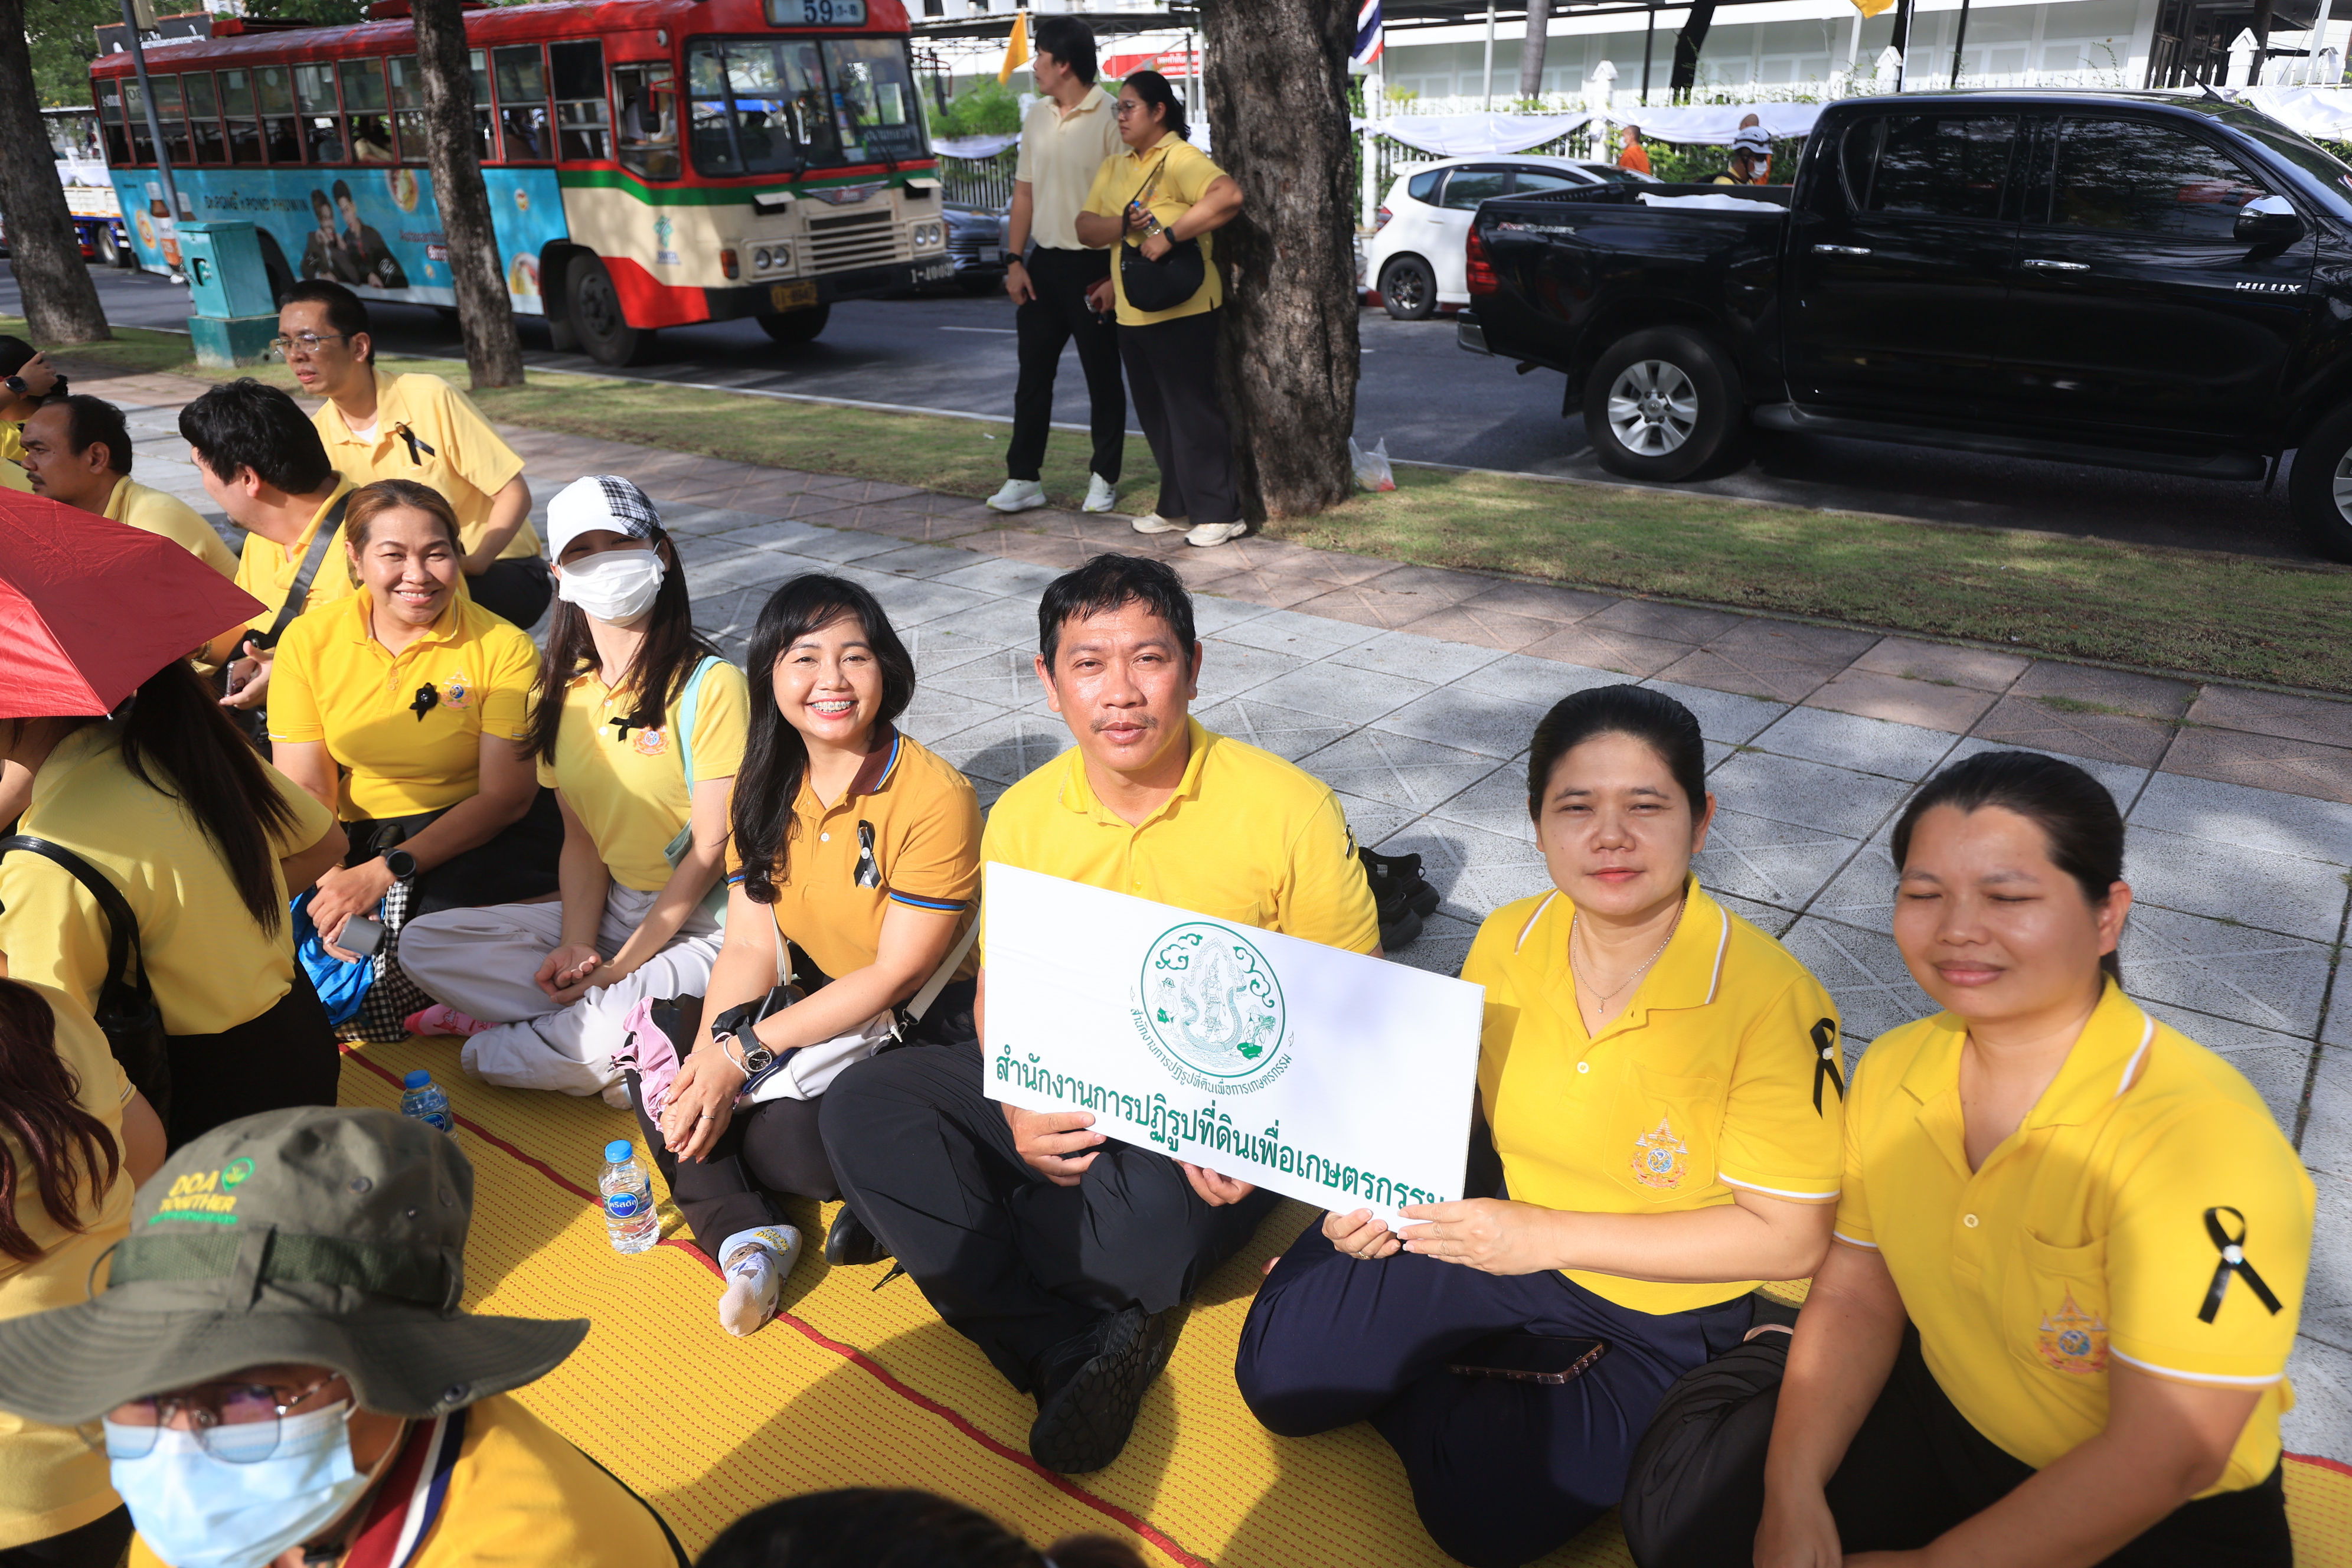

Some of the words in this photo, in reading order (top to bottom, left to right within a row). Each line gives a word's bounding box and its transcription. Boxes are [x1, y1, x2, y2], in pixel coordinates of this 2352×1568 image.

[803, 0, 834, 24] 59
[2234, 282, 2302, 294] HILUX
[168, 1170, 220, 1198] DOA
